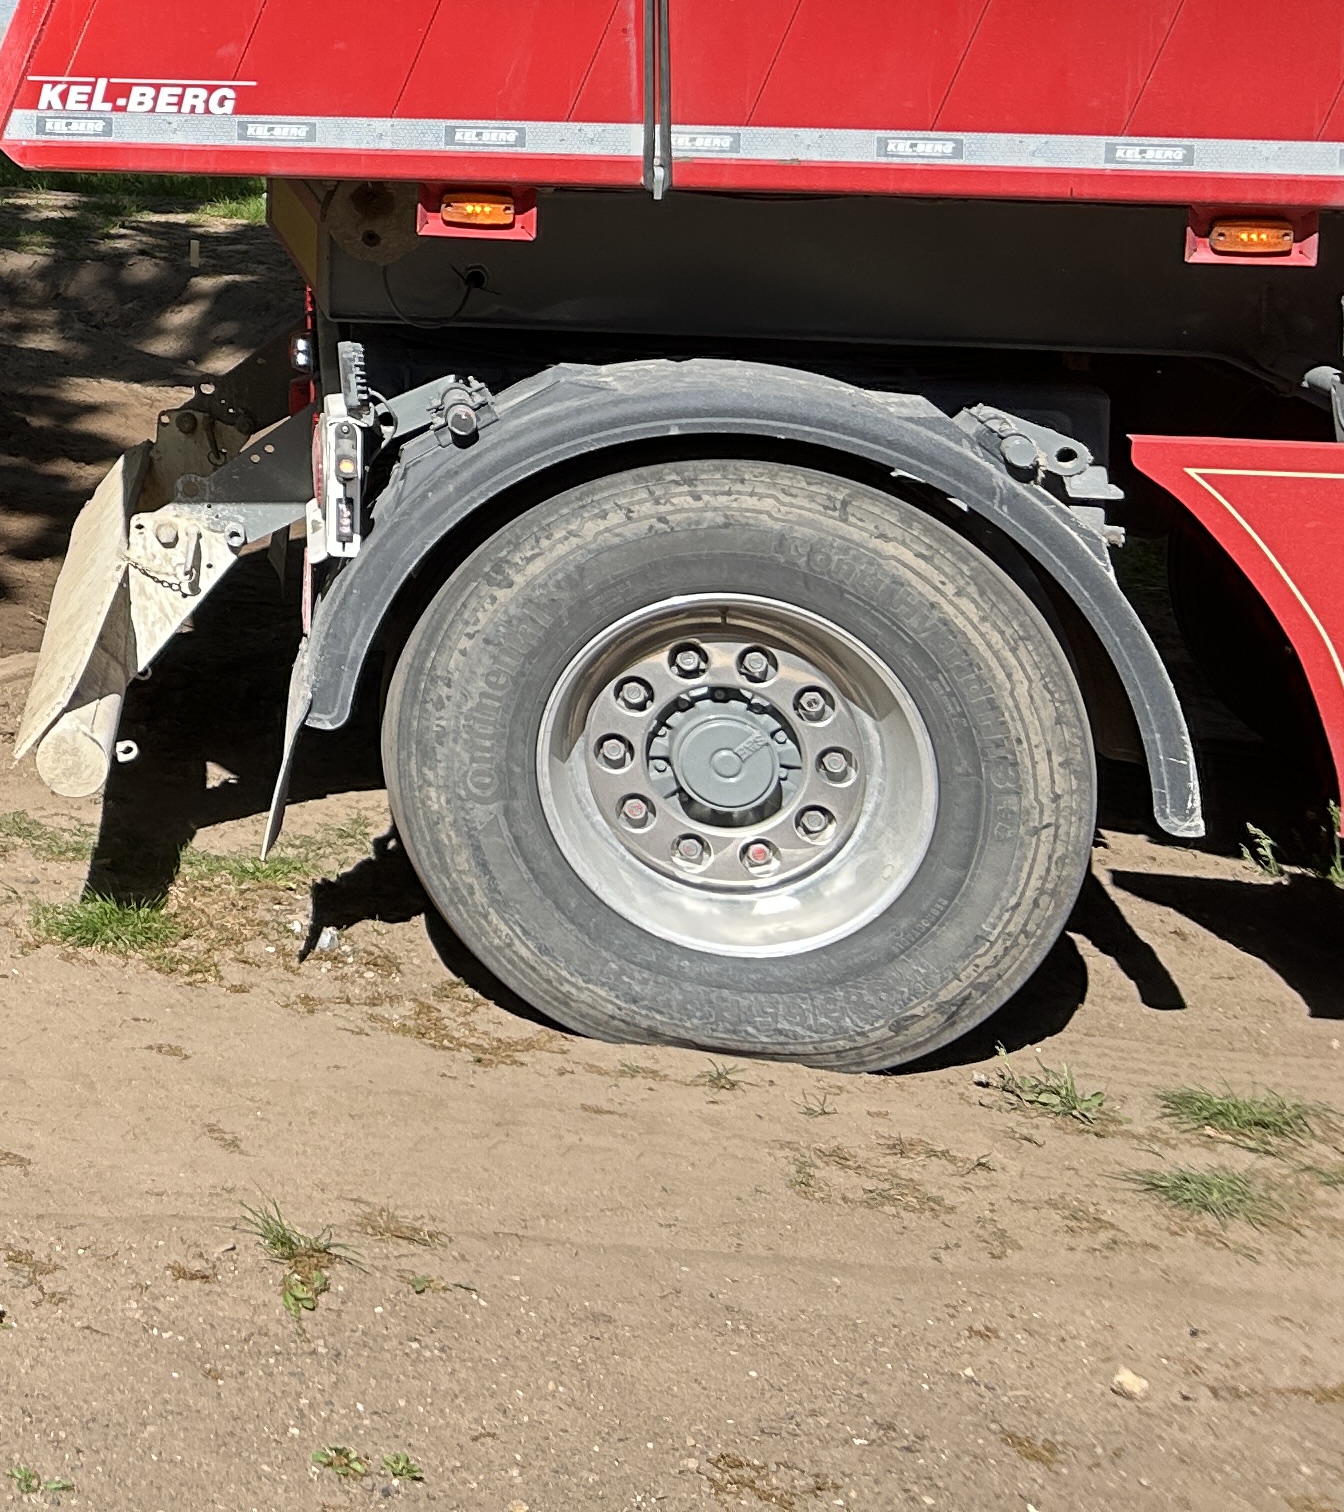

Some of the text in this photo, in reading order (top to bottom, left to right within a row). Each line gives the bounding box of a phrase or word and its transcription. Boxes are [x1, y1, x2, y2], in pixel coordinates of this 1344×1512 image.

[37, 78, 236, 114] KEL-BERG
[45, 119, 105, 133] KEL-BERG
[246, 124, 309, 138] KEL-BERG
[454, 130, 517, 143] KEL-BERG
[886, 141, 954, 155] KEL-BERG
[1115, 147, 1184, 160] KEL-BERG
